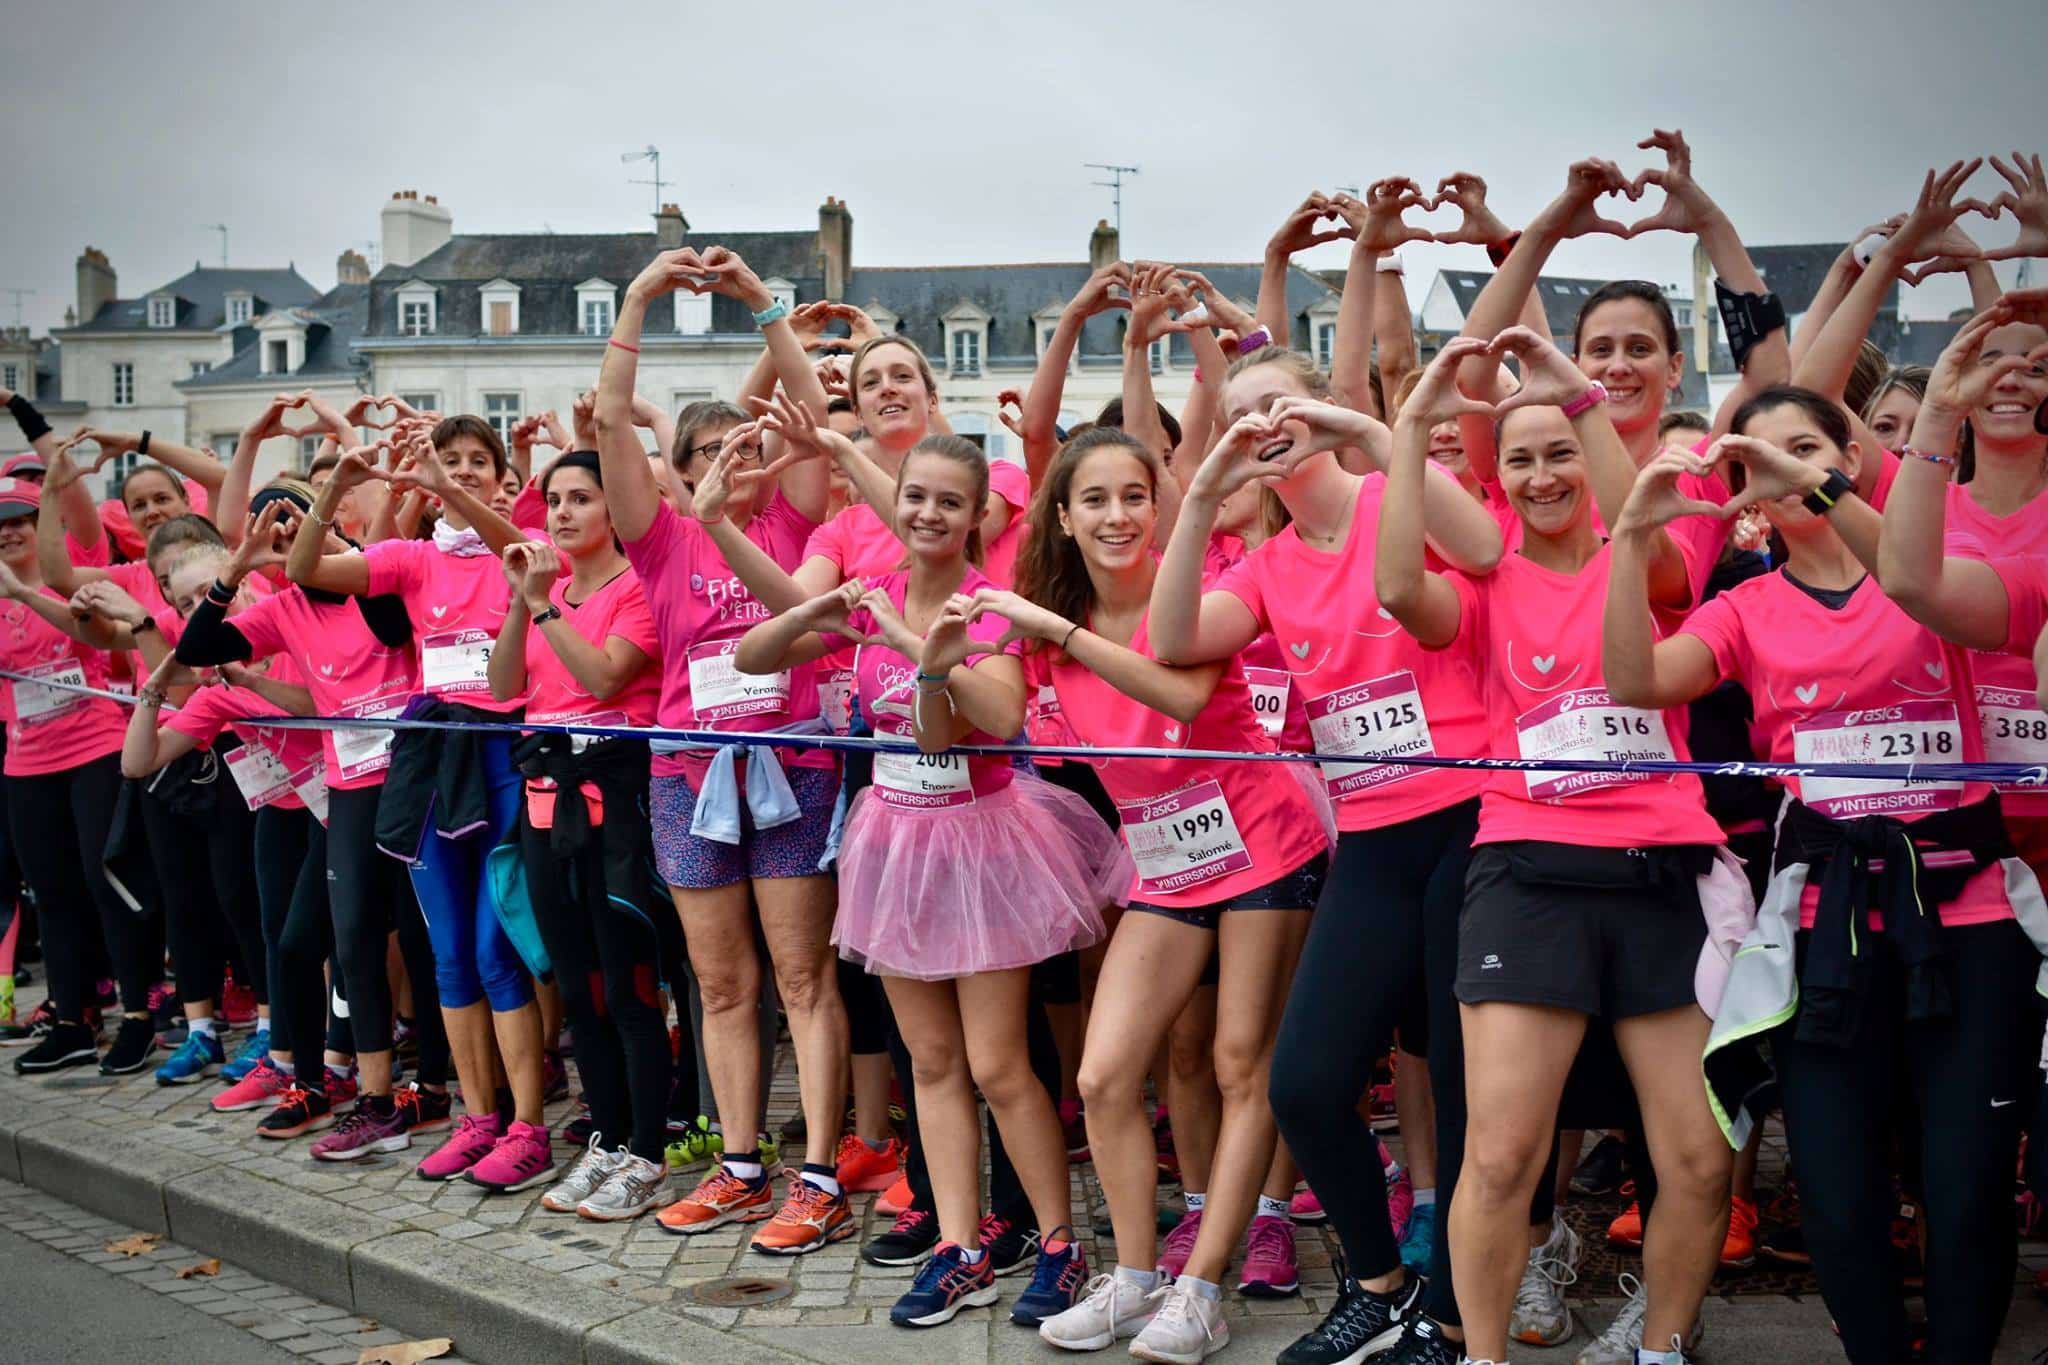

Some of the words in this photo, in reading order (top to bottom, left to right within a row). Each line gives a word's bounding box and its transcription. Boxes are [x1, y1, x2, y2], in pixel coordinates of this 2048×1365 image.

[1250, 694, 1280, 713] 00
[1355, 703, 1418, 737] 3125
[1603, 717, 1650, 736] 516
[1880, 731, 1953, 757] 2318
[888, 792, 951, 806] INTERSPORT
[1843, 793, 1936, 812] INTERSPORT
[1172, 808, 1224, 842] 1999
[1187, 840, 1233, 864] Salomé
[1161, 860, 1228, 888] INTERSPORT
